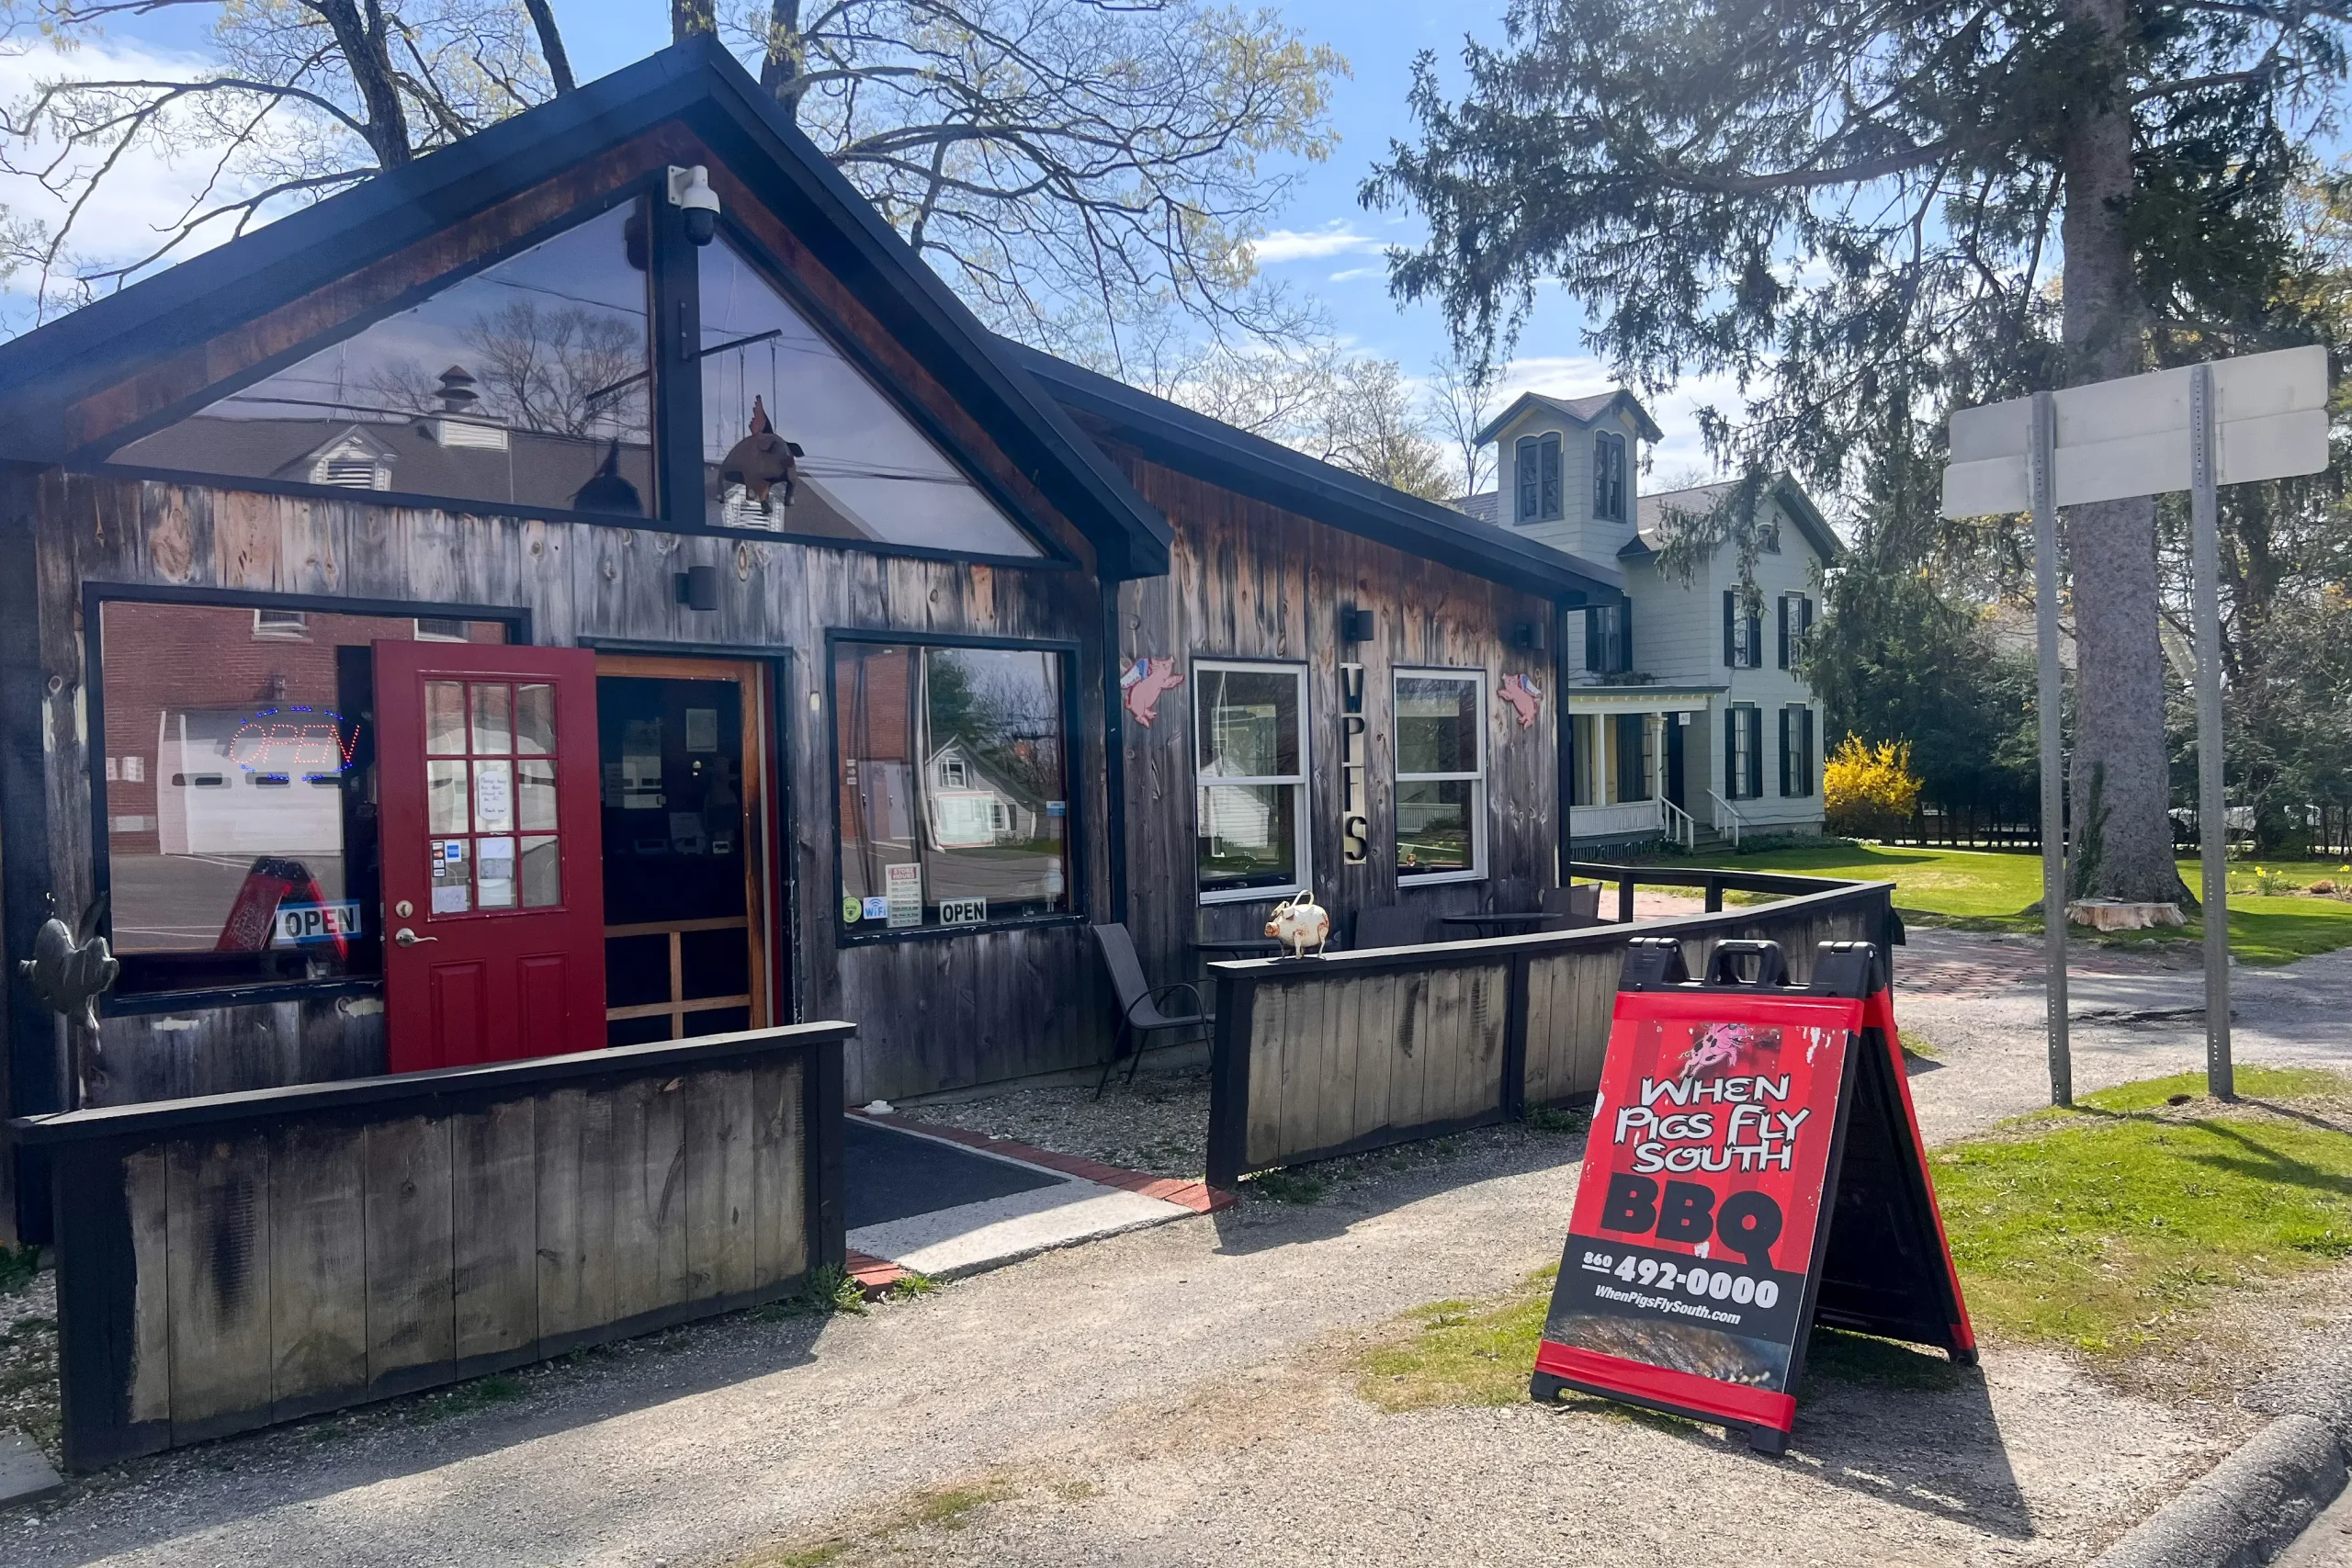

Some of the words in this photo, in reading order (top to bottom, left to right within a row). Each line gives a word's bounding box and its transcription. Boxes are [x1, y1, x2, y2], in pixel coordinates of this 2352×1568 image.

[230, 724, 361, 763] OPEN
[285, 908, 355, 937] OPEN
[865, 907, 886, 917] WiFi
[943, 902, 984, 923] OPEN
[1641, 1074, 1791, 1106] WHEN
[1631, 1140, 1792, 1173] SOUTH
[1600, 1172, 1782, 1270] BBQ
[1583, 1251, 1613, 1268] 860
[1613, 1256, 1779, 1309] 492-0000
[1595, 1285, 1741, 1325] WhenPigsFlySouth.com
